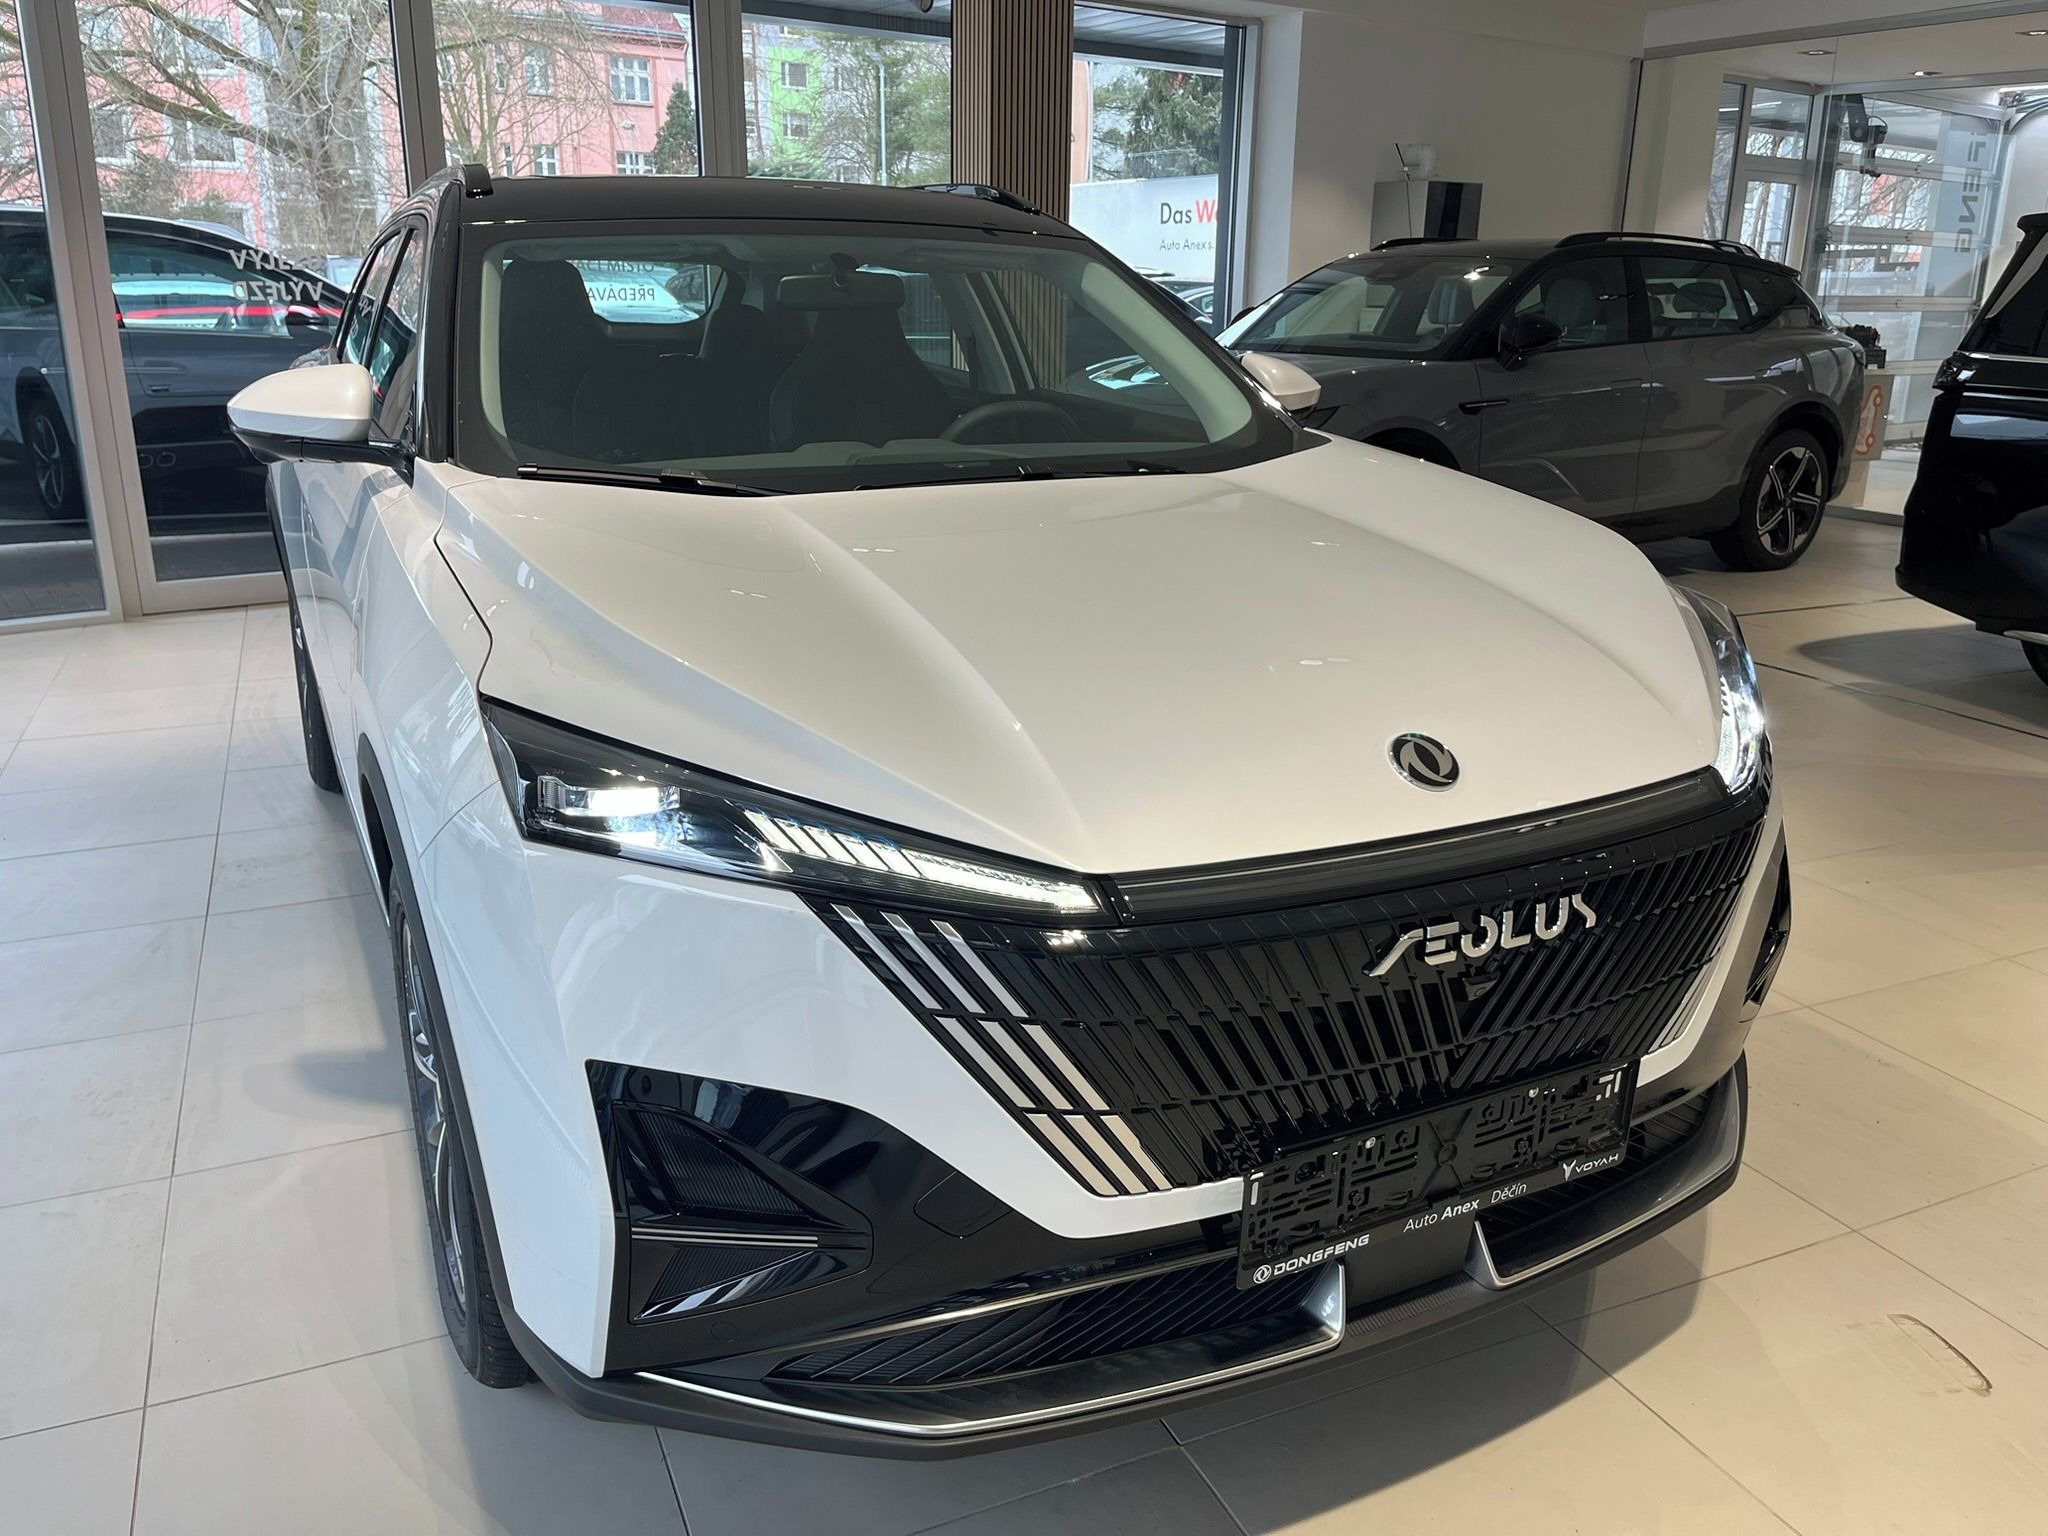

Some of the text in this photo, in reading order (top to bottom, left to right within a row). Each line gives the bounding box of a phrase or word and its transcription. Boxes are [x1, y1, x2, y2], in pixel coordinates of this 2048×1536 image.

[1160, 199, 1218, 224] Das W
[1160, 239, 1181, 251] Auto
[1574, 1153, 1619, 1173] VOYAH
[1403, 1182, 1526, 1232] Auto Anex Děčín
[1273, 1234, 1370, 1275] DONGFENG
